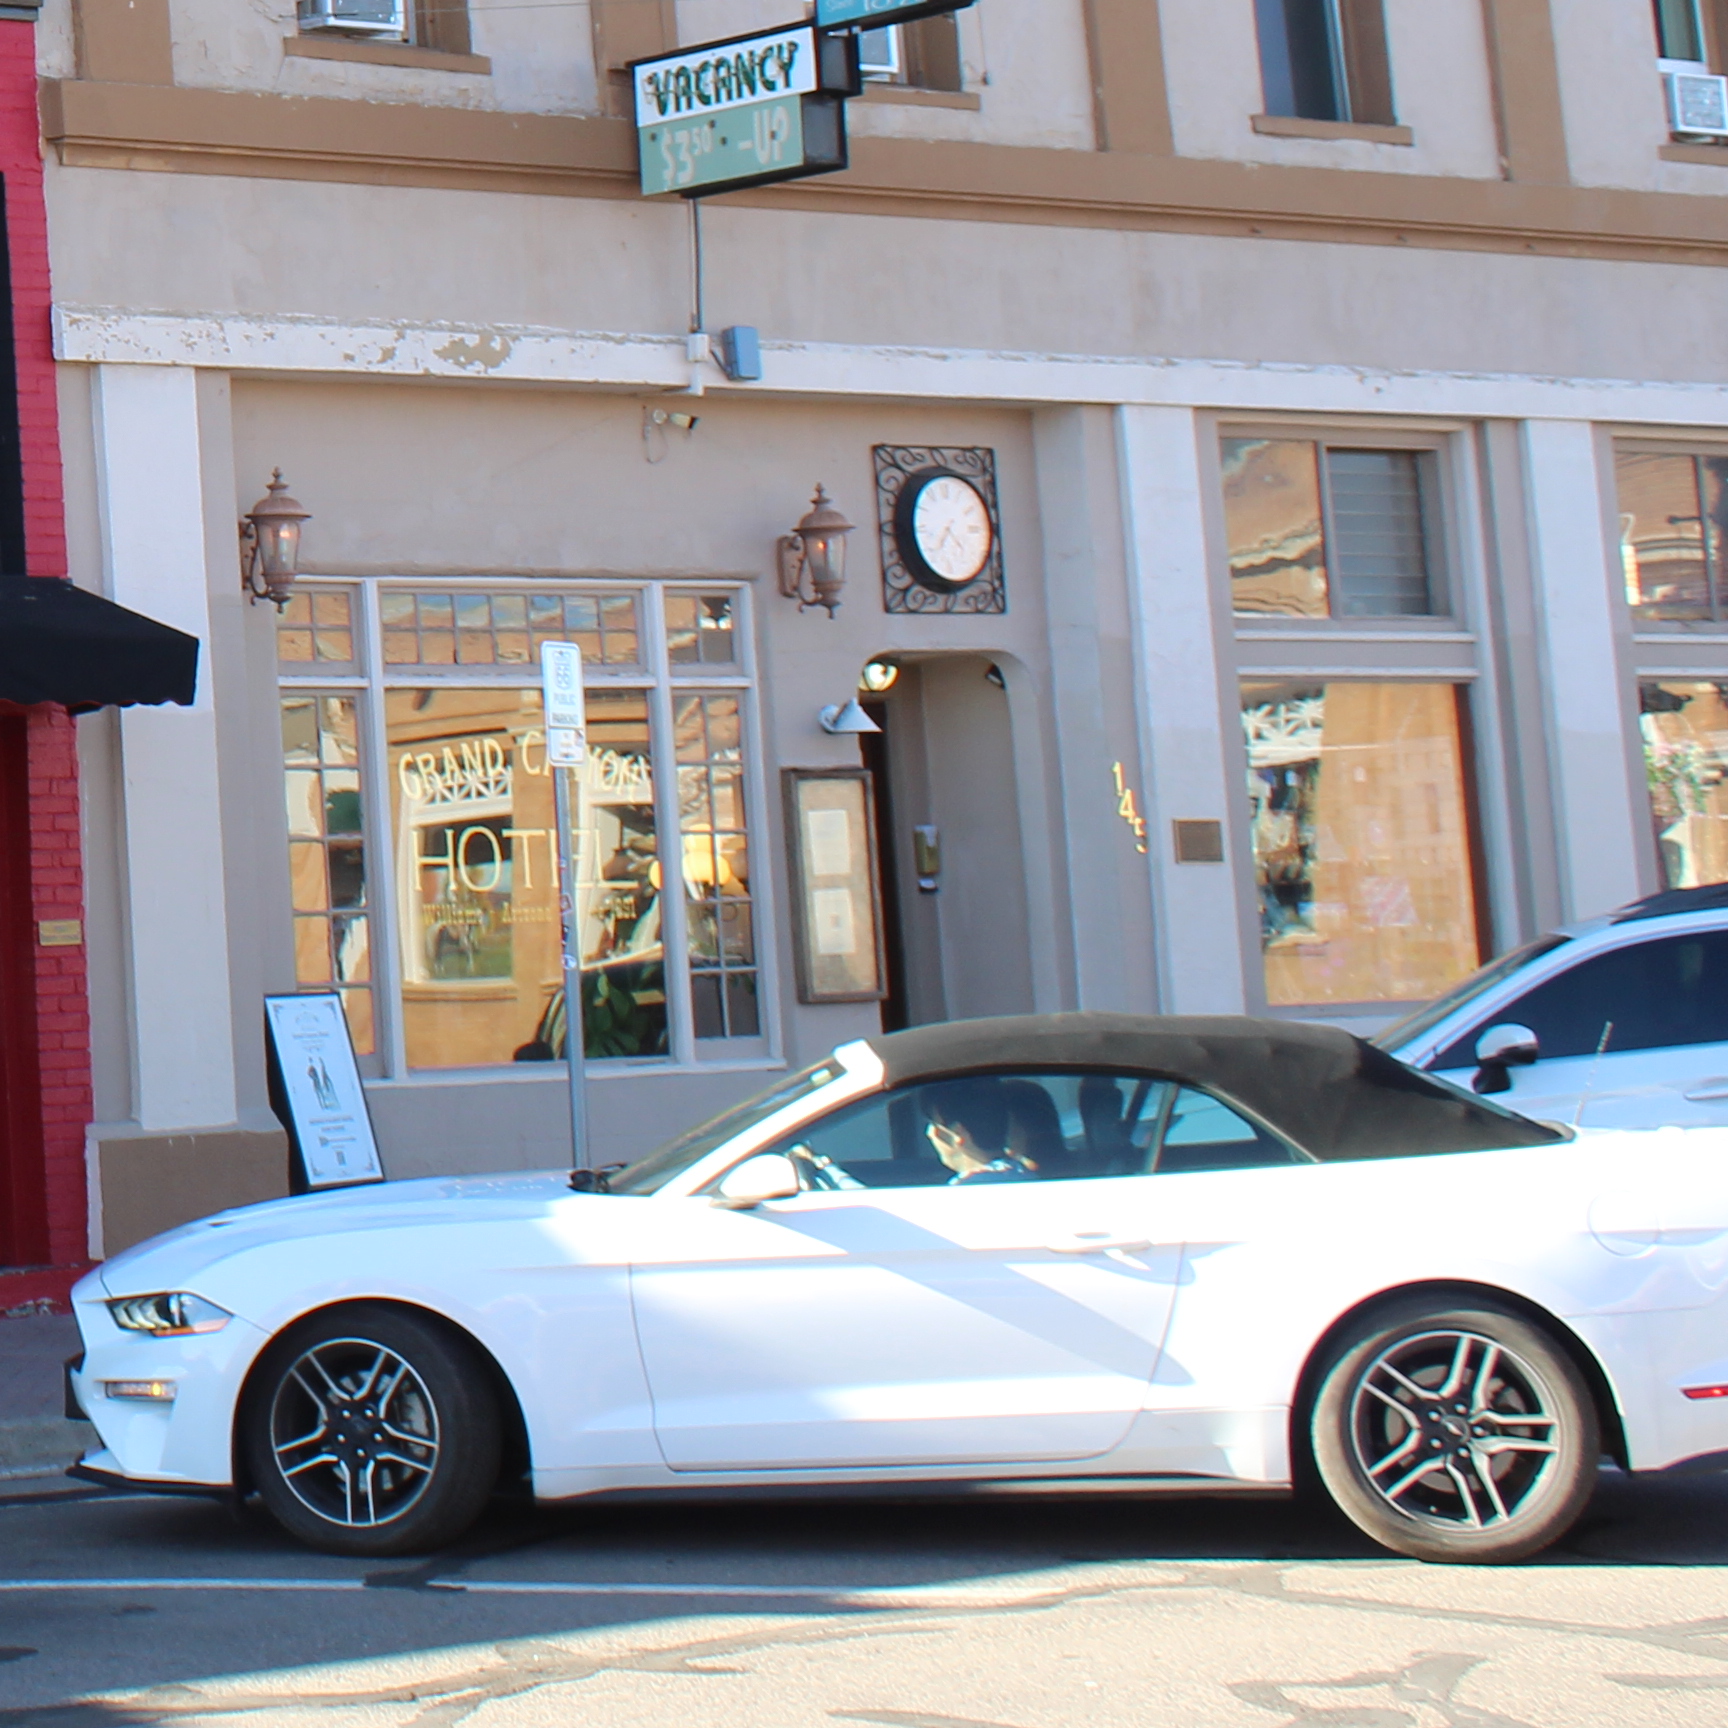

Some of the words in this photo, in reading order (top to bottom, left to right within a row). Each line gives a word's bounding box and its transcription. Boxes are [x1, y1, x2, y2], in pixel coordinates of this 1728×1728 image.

[647, 40, 799, 117] VACANCY
[399, 737, 506, 801] GRAND
[411, 825, 640, 892] HOTEL
